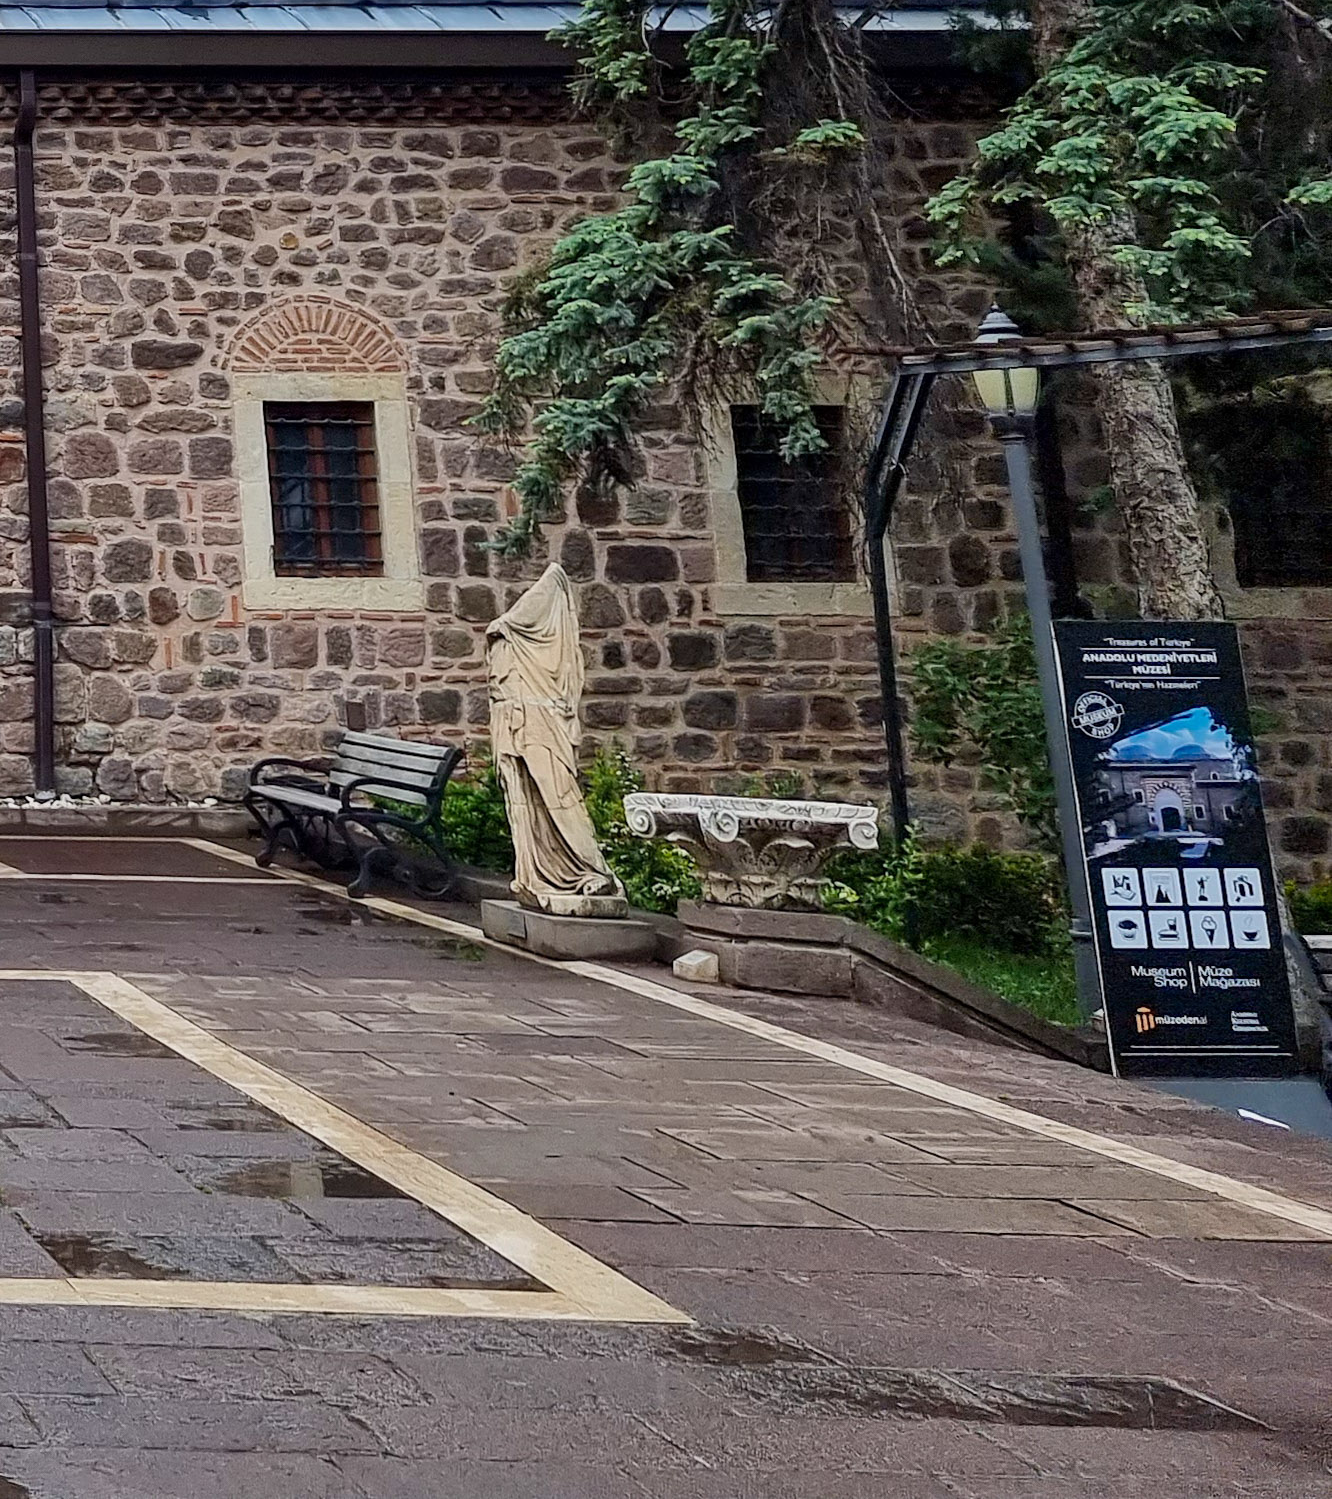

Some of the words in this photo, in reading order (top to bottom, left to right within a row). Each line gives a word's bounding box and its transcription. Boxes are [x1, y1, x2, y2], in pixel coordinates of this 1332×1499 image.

[1082, 653, 1136, 663] ANADOLU
[1136, 651, 1218, 664] MEDENİYETLERİ
[1132, 663, 1172, 675] MÜZESİ
[1079, 707, 1117, 725] MUSEUM
[1091, 723, 1115, 736] SHOP
[1130, 965, 1186, 977] Museum
[1197, 965, 1233, 977] Müze
[1154, 976, 1188, 989] Shop
